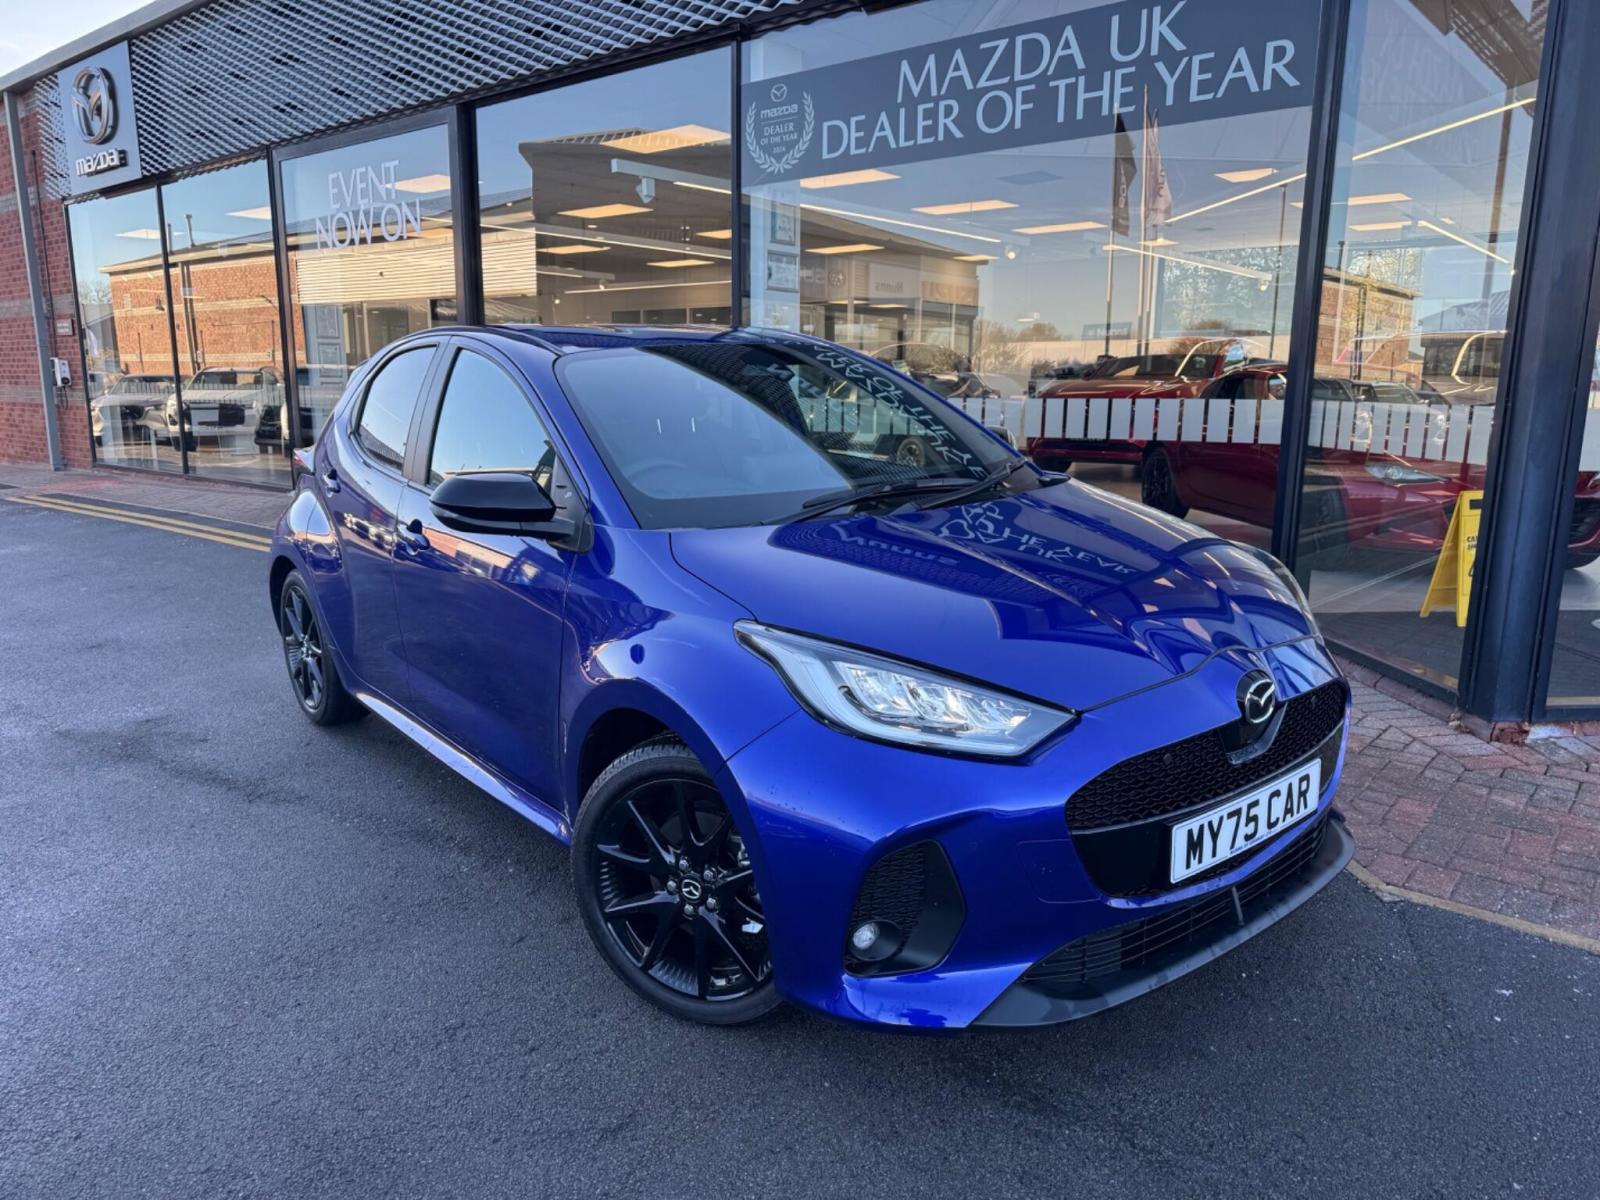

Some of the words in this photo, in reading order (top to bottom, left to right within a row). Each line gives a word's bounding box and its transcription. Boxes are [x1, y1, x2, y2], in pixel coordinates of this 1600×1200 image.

[896, 24, 1086, 103] MAZDA
[1110, 1, 1188, 63] UK
[763, 122, 795, 136] DEALER
[821, 98, 964, 160] DEALER
[976, 84, 1036, 134] OF
[1048, 66, 1136, 124] THE
[1154, 38, 1300, 107] YEAR
[328, 159, 399, 208] EVENT
[314, 204, 374, 250] NOW
[382, 199, 422, 242] ON
[1185, 798, 1260, 870] MY75
[1266, 773, 1311, 830] CAR
